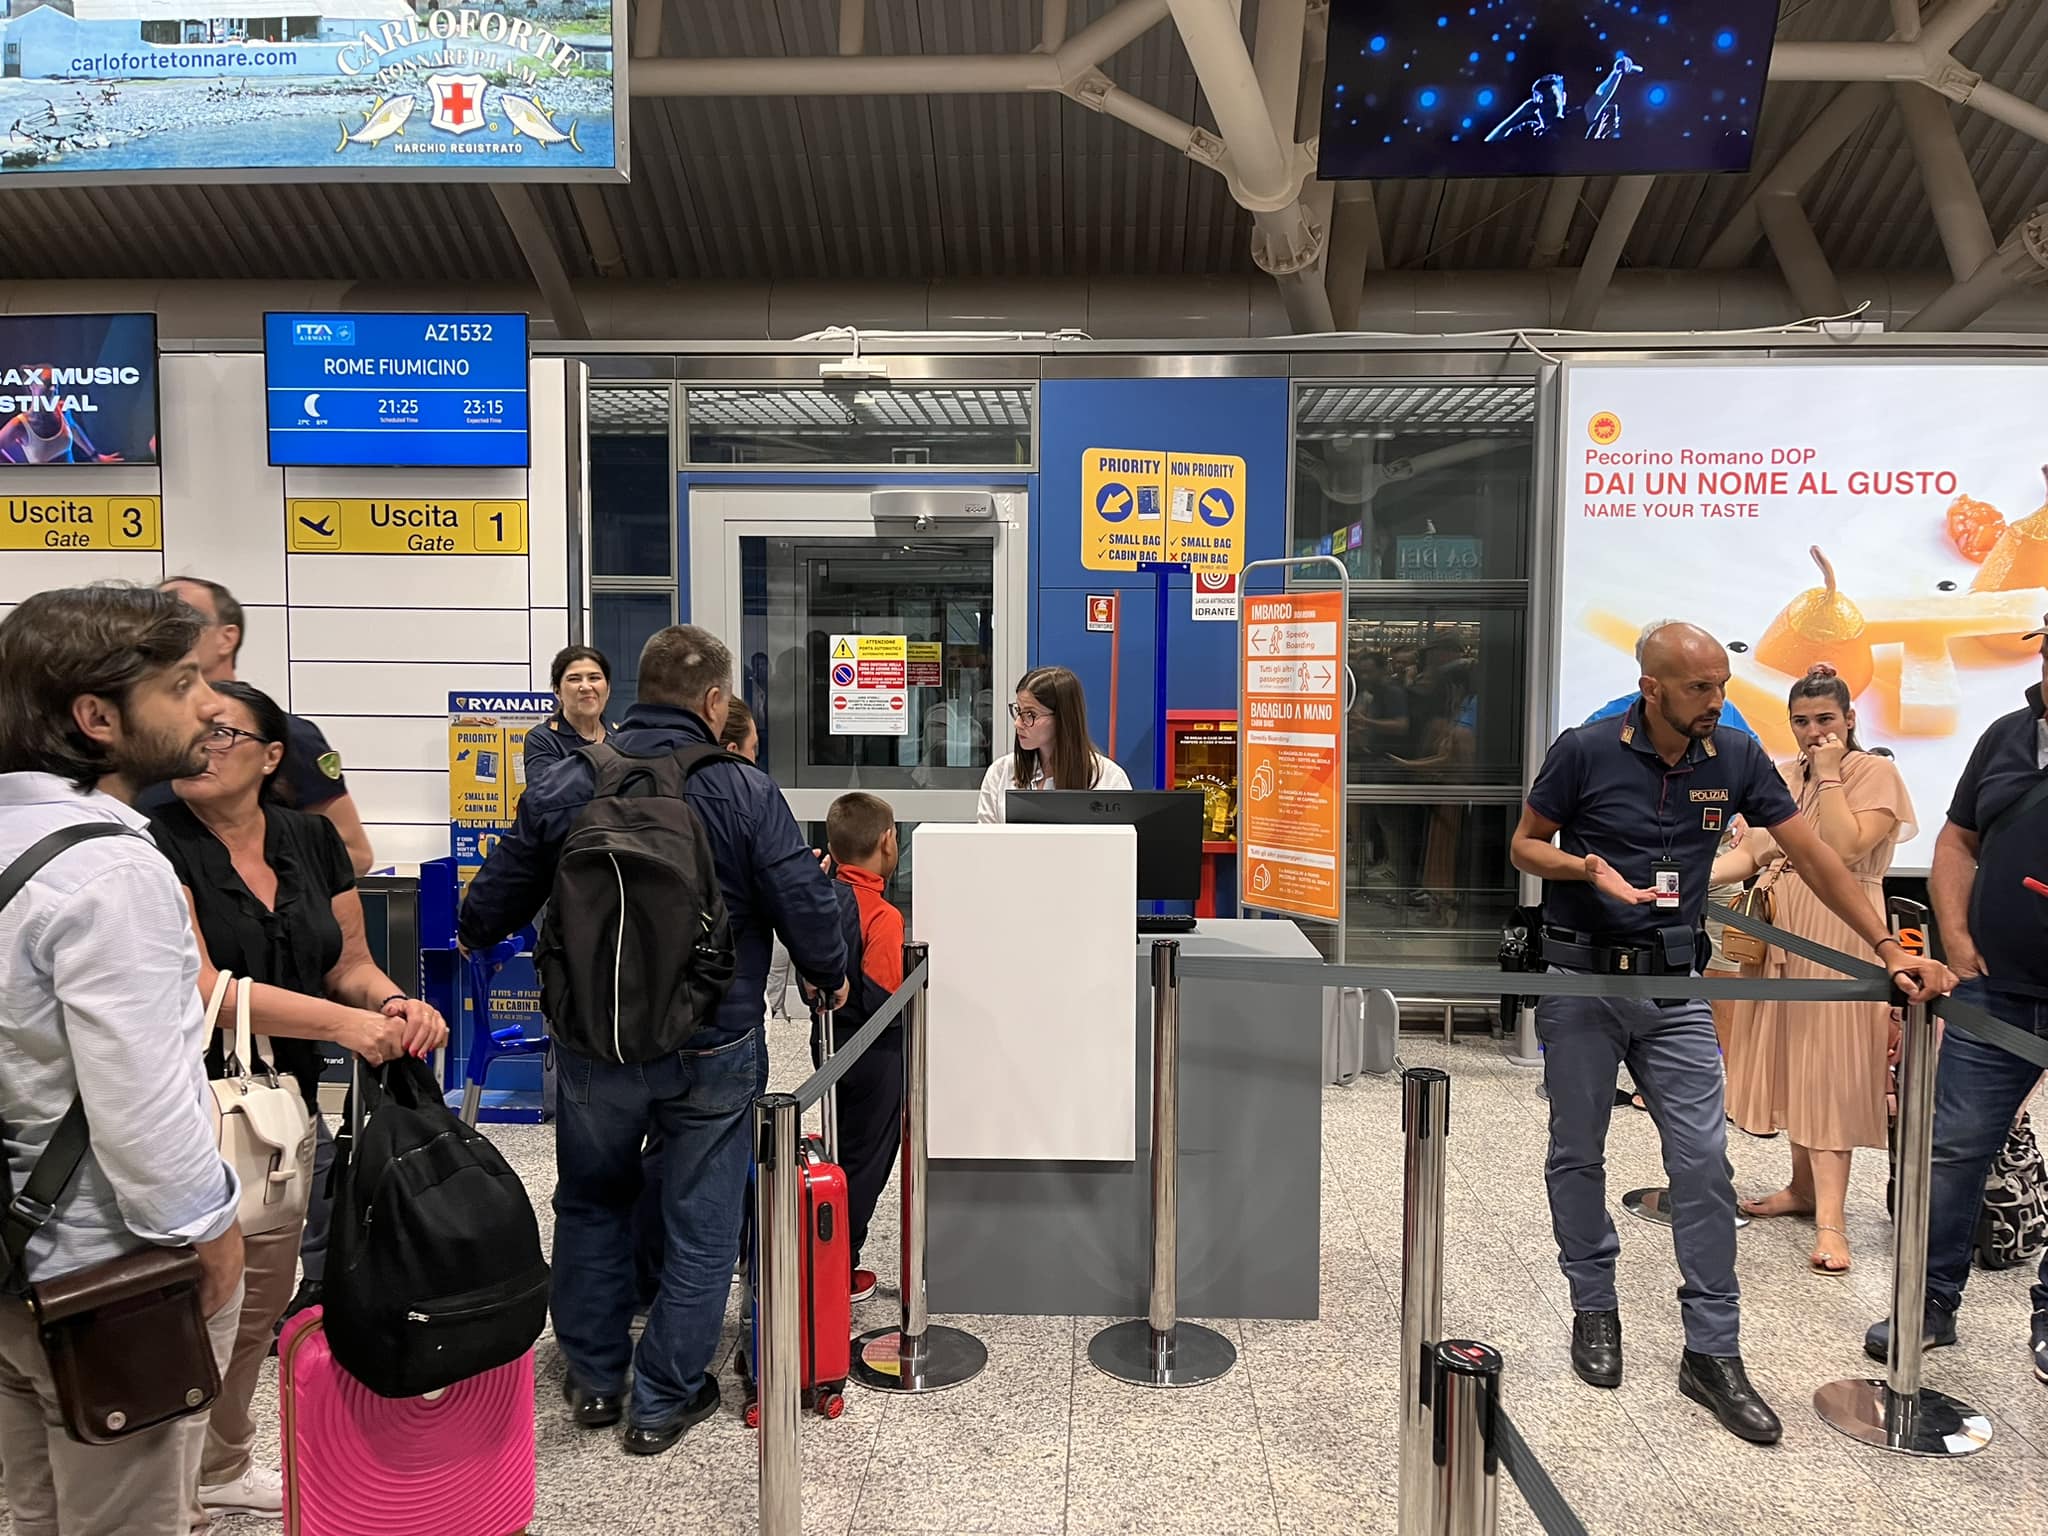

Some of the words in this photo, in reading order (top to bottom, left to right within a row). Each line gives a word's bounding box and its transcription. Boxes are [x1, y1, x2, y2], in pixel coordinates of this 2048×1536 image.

[337, 9, 581, 77] CARLOFORTE
[71, 48, 297, 73] carlofortetonnare.com
[376, 50, 466, 86] TONNARE
[394, 143, 447, 154] MARCHIO
[450, 143, 522, 154] REGISTRATO
[296, 324, 333, 336] ITA
[425, 324, 492, 342] AZ1532
[324, 358, 375, 375] ROME
[379, 359, 469, 376] FIUMICINO
[0, 368, 44, 386] AX
[51, 367, 140, 385] MUSIC
[378, 399, 419, 414] 21:25
[463, 400, 504, 414] 23:15
[1585, 449, 1673, 465] Pecorino
[1681, 449, 1763, 465] Romano
[1771, 449, 1816, 465] DOP
[1099, 457, 1160, 474] PRIORITY
[1171, 462, 1190, 476] NON
[1192, 463, 1234, 478] PRIORITY
[1585, 472, 1634, 496] DAI
[1645, 472, 1686, 495] UN
[1698, 472, 1788, 495] NOME
[1798, 471, 1838, 495] AL
[1848, 471, 1957, 495] GUSTO
[9, 501, 93, 523] Uscita
[370, 504, 458, 528] Uscita
[1584, 504, 1636, 518] NAME
[1643, 504, 1694, 518] YOUR
[1702, 504, 1759, 518] TASTE
[122, 508, 143, 538] 3
[490, 511, 503, 541] 1
[45, 531, 90, 547] Gate
[407, 534, 455, 552] Gate
[1109, 534, 1140, 545] SMALL
[1142, 535, 1161, 545] BAG
[1181, 537, 1212, 548] SMALL
[1214, 538, 1231, 549] BAG
[1109, 550, 1137, 561] CABIN
[1139, 551, 1157, 561] BAG
[1181, 552, 1208, 563] CABIN
[1210, 554, 1228, 564] BAG
[1195, 607, 1236, 616] IDRANTE
[1251, 603, 1292, 620] IMBARCO
[1286, 630, 1309, 639] Speedy
[1286, 641, 1315, 650] Boarding
[1259, 676, 1292, 684] passeggeri
[468, 698, 553, 711] RYANAIR
[1251, 703, 1293, 719] BAGAGLIO
[1294, 704, 1302, 719] A
[1304, 704, 1332, 720] MANO
[458, 733, 497, 743] PRIORITY
[510, 735, 523, 744] NON
[487, 793, 499, 801] BAG
[1691, 790, 1727, 800] POLIZIA
[464, 804, 483, 812] CABIN
[485, 804, 497, 812] BAG
[1105, 803, 1121, 812] LG
[458, 819, 472, 828] YOU
[473, 819, 493, 829] CAN'T
[495, 819, 513, 829] BRIN
[506, 1001, 531, 1010] CABIN
